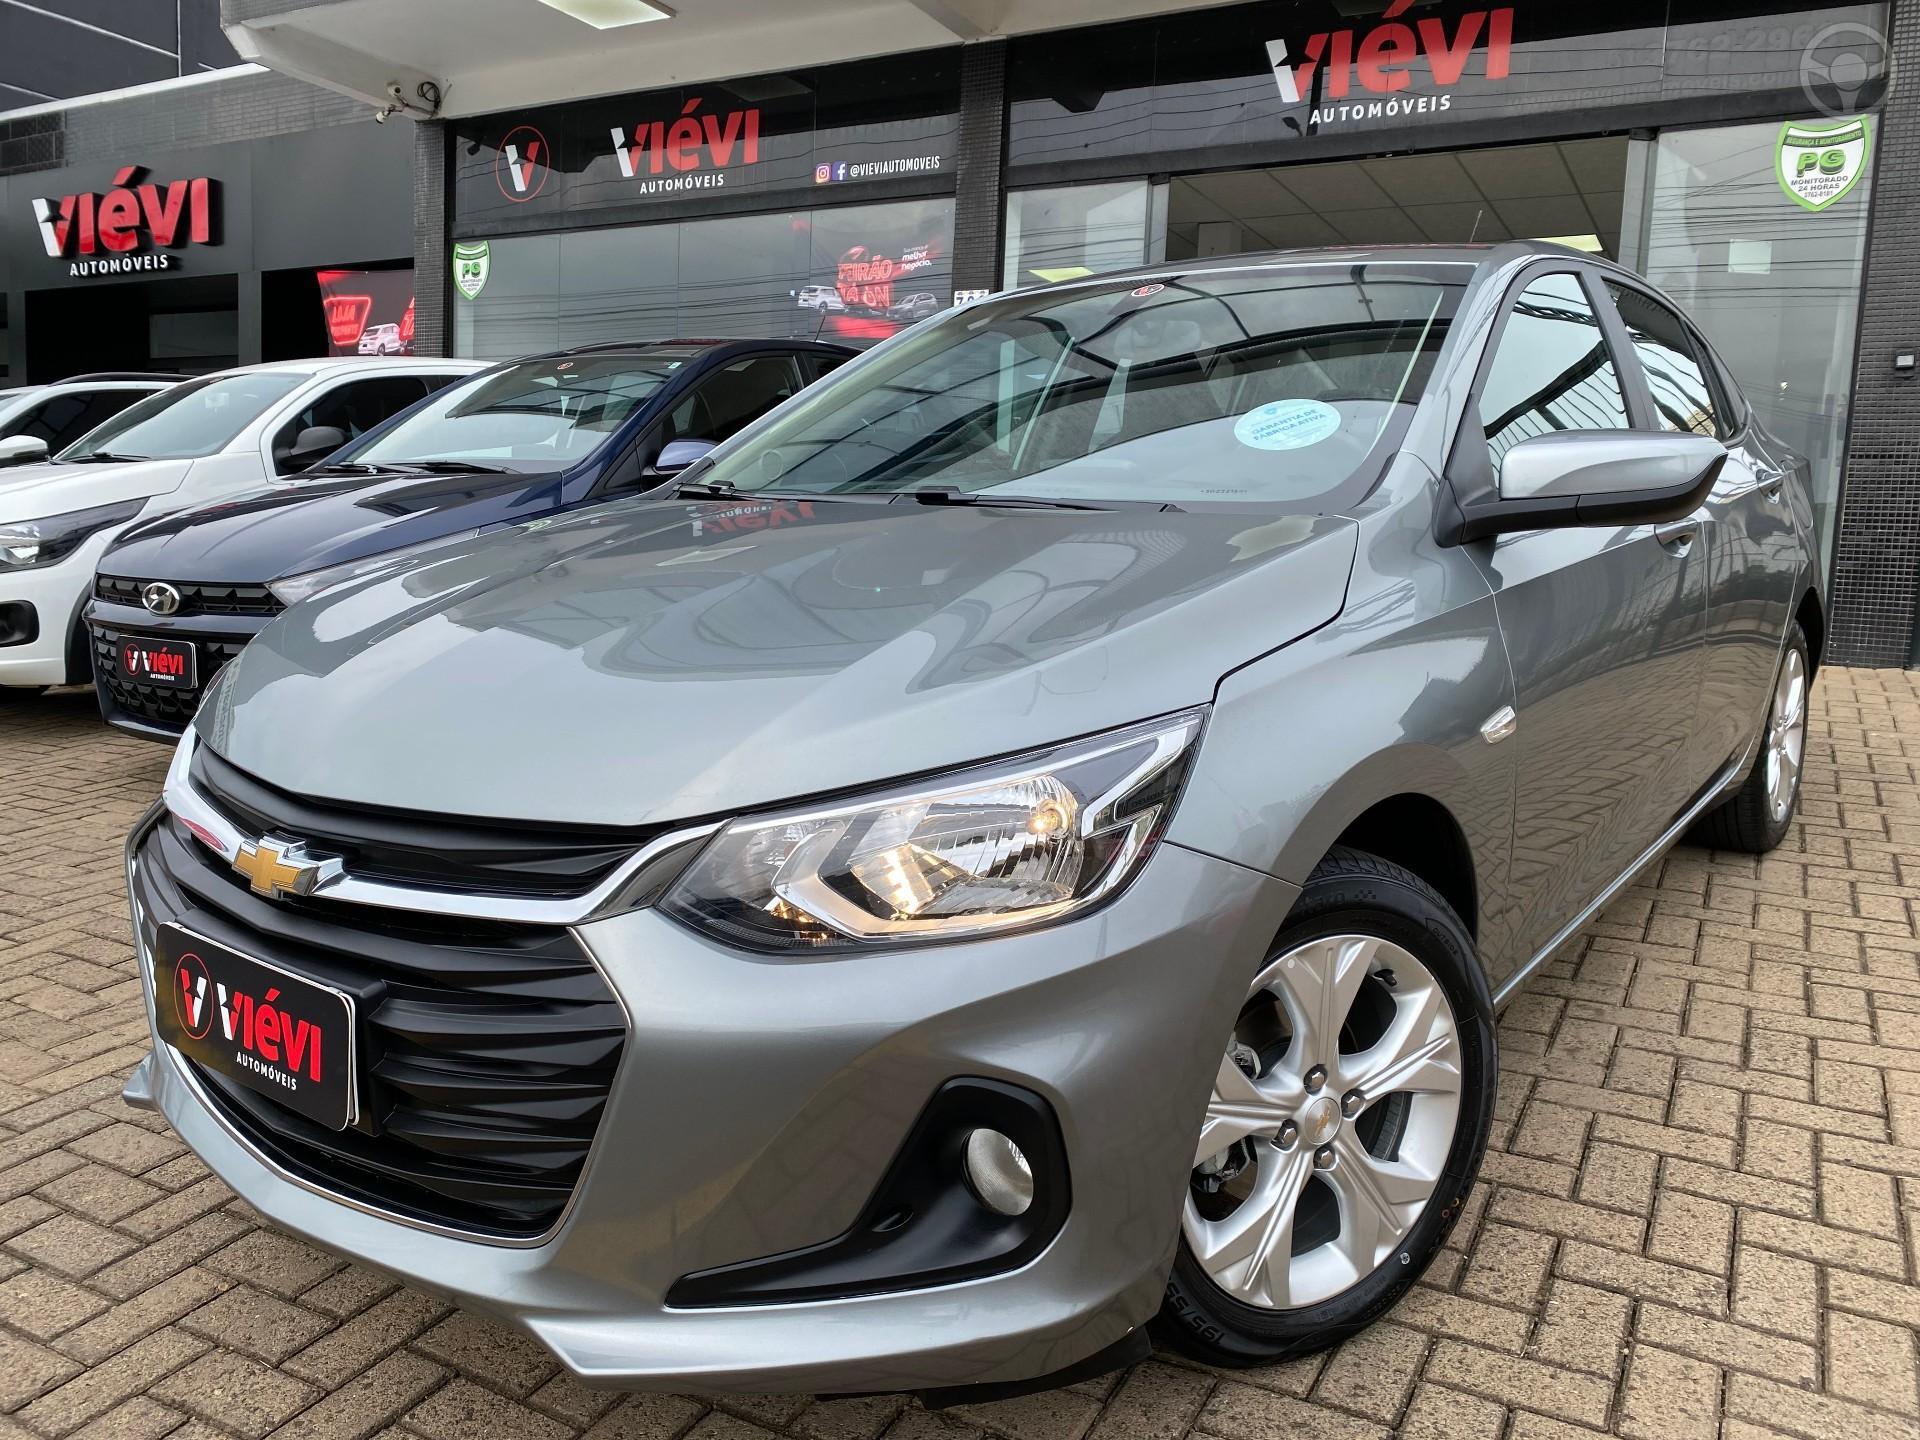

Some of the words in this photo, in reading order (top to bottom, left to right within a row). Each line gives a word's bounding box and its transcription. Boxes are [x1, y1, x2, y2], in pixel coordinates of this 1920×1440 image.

[1309, 94, 1452, 125] AUTOMÓVEIS
[850, 156, 941, 178] @VIEVIAUTOMOVEIS
[1796, 149, 1846, 178] PG
[640, 174, 725, 195] AUTOMÓVEIS
[1790, 175, 1849, 186] MONITORADO
[1810, 182, 1840, 191] HORAS
[69, 253, 169, 277] AUTOMÓVEIS
[1252, 413, 1303, 435] GARANTIA
[1303, 408, 1318, 417] DE
[1297, 413, 1327, 425] ATIVA
[236, 1051, 297, 1091] AUTOMÓVEIS
